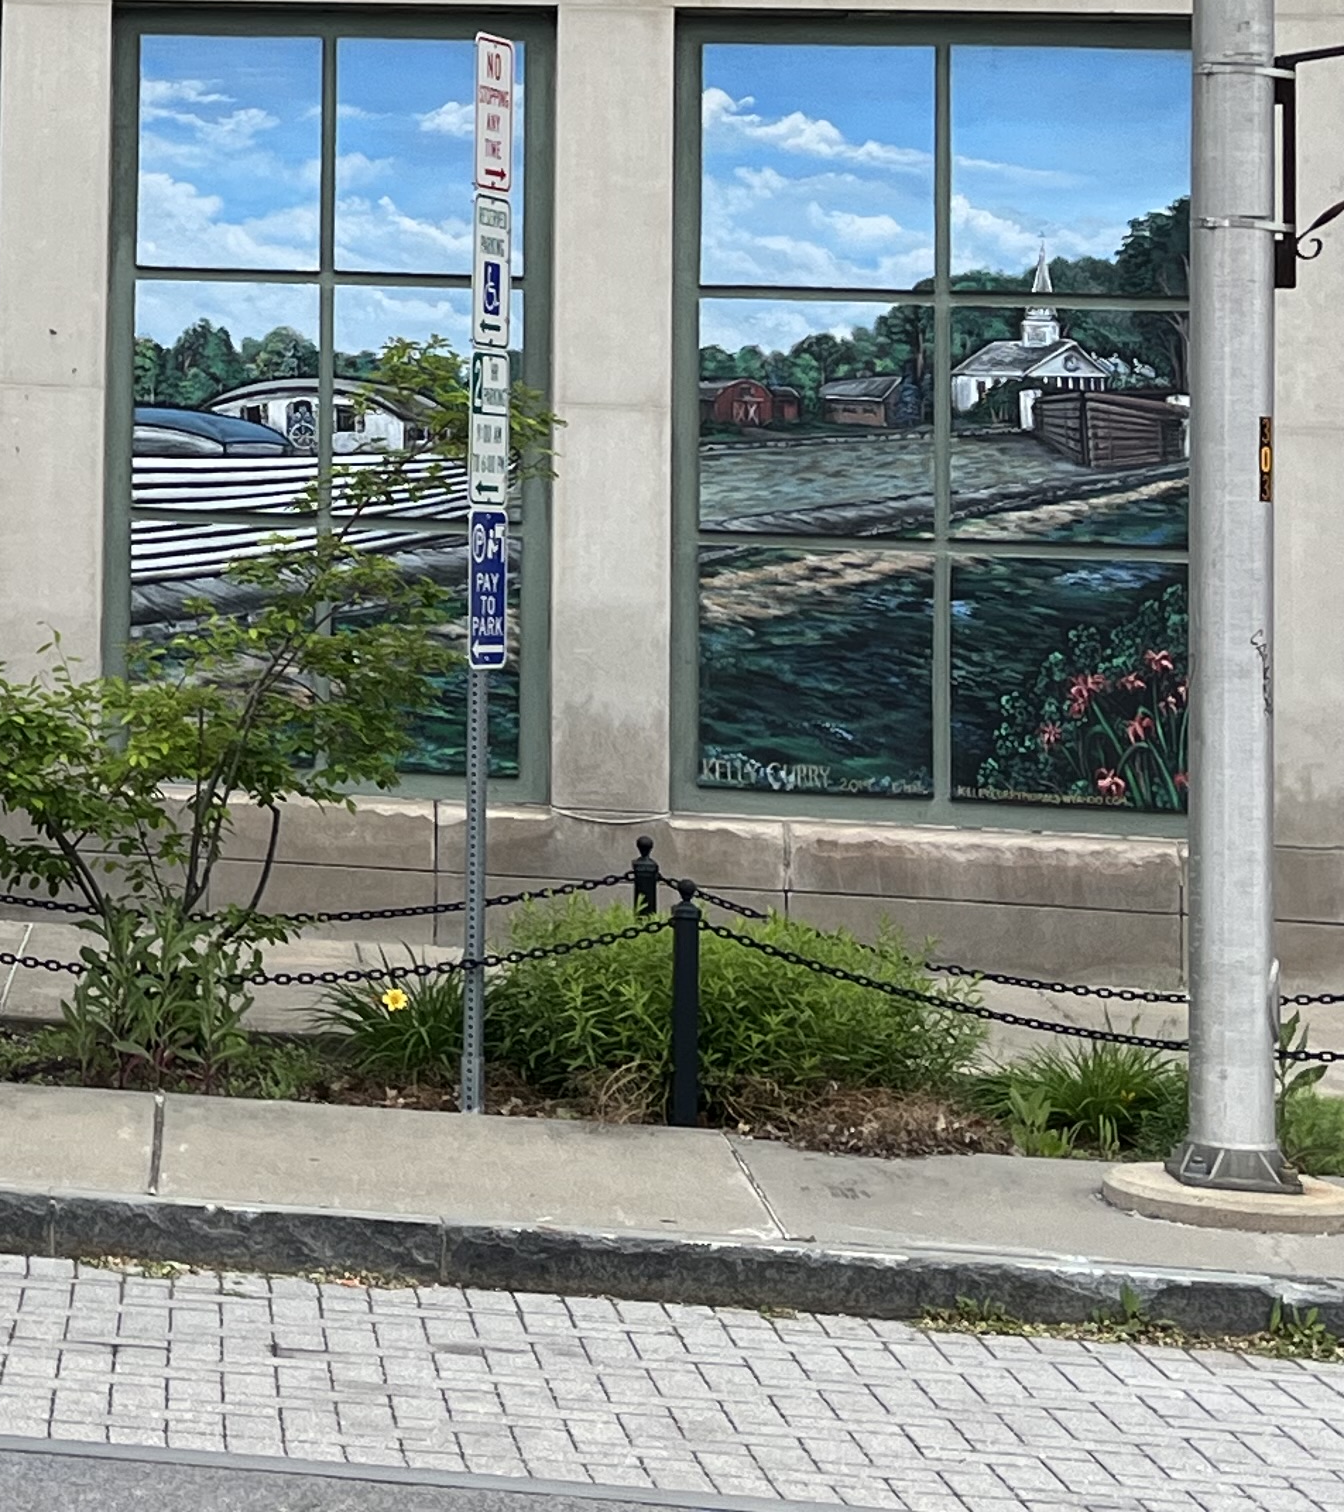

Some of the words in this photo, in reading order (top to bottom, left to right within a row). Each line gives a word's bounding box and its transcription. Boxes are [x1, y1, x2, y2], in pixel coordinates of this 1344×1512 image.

[486, 51, 502, 81] NO
[486, 113, 501, 133] ANY
[474, 359, 482, 407] 2
[476, 572, 500, 594] PAY
[479, 595, 496, 615] TO
[472, 616, 504, 637] PARK
[702, 757, 759, 785] KELLY
[767, 762, 831, 791] CURRY
